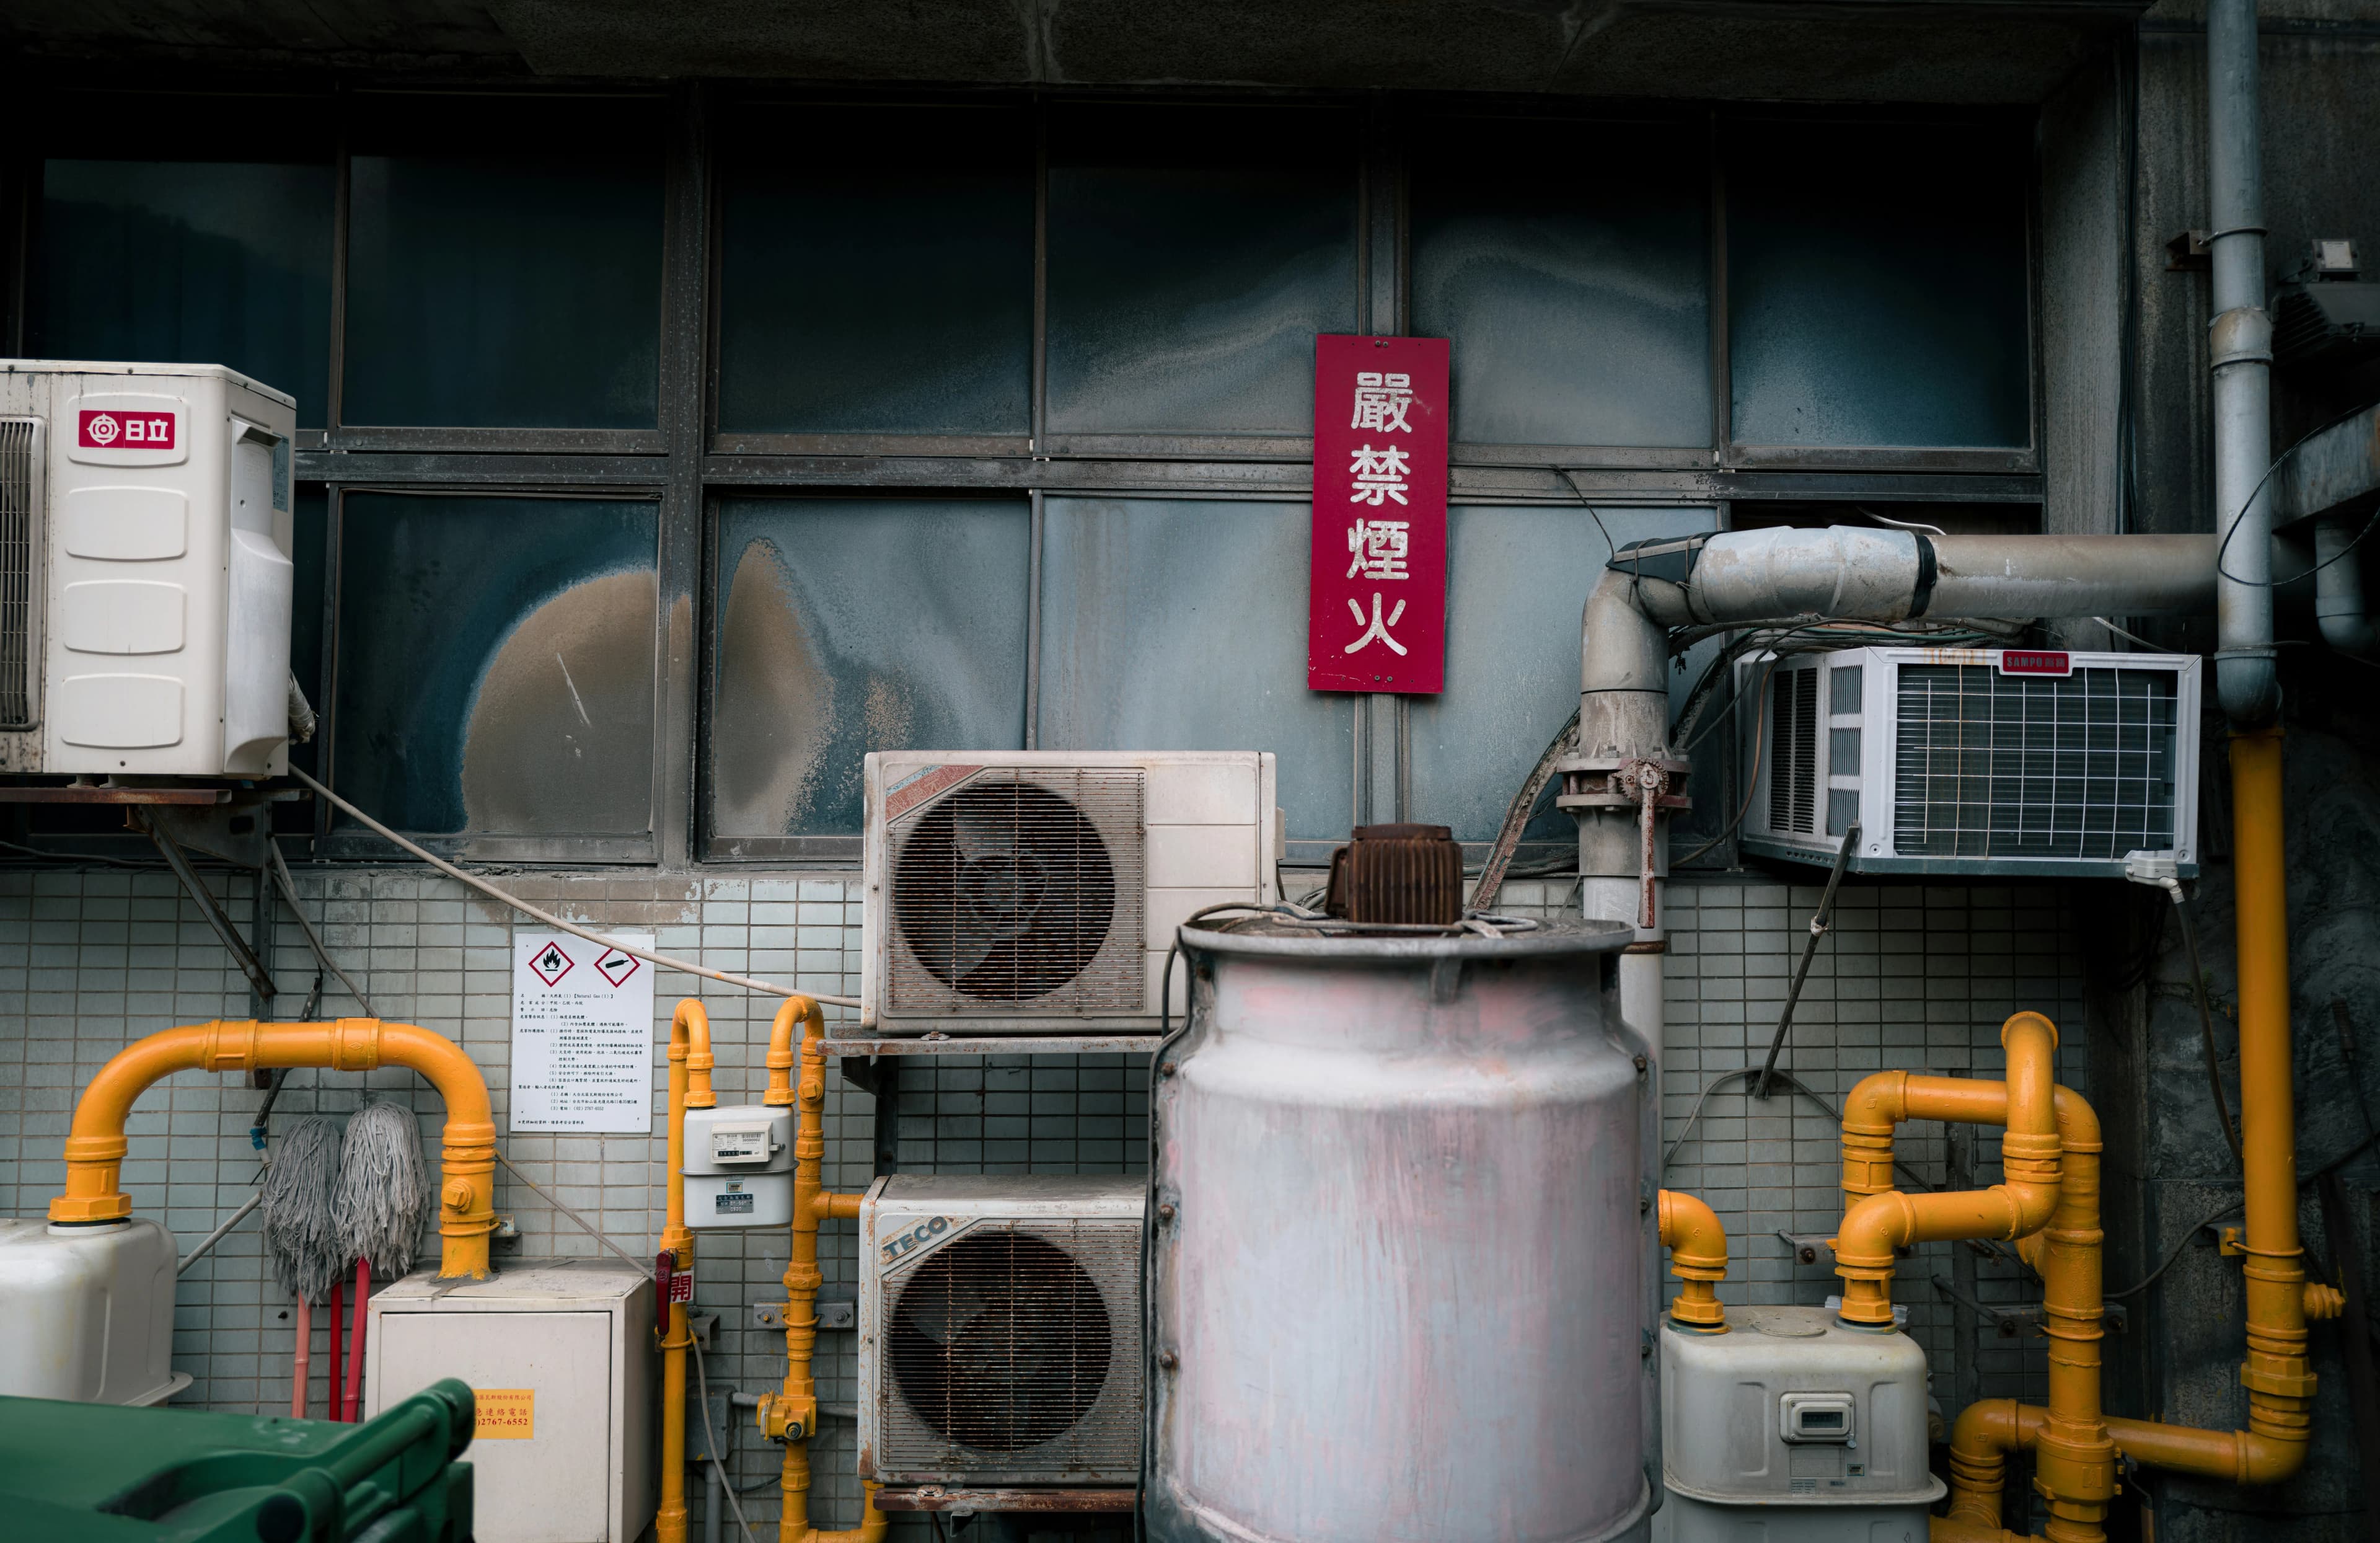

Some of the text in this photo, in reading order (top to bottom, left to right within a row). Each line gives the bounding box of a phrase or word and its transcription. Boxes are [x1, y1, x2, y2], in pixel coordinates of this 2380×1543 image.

[125, 418, 169, 441] 日立
[1344, 372, 1412, 656] 嚴禁煙火
[2007, 657, 2042, 667] SAMPO
[883, 1216, 948, 1257] TECO
[671, 1275, 692, 1301] 開
